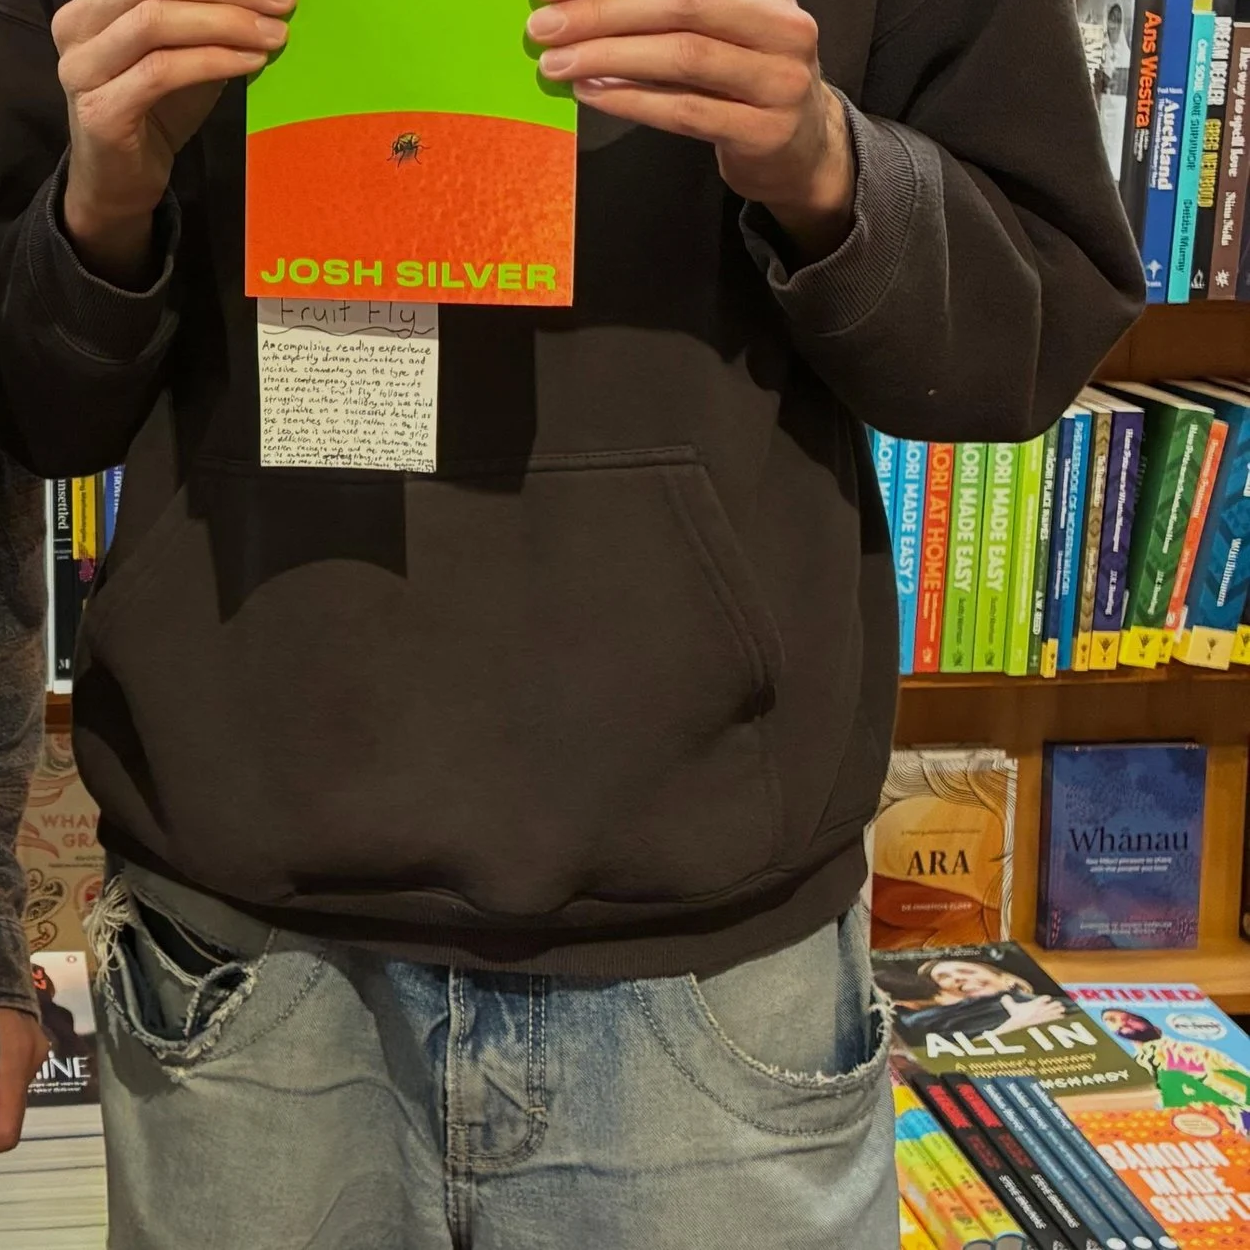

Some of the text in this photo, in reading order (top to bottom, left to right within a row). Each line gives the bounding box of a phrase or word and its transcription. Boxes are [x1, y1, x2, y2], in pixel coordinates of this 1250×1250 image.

[1136, 11, 1162, 128] Ans Westra
[1157, 98, 1181, 190] Auckland
[261, 257, 557, 290] JOSH SILVER
[953, 488, 975, 594] MADE EASY
[906, 849, 971, 876] ARA
[925, 1021, 1098, 1059] ALL IN
